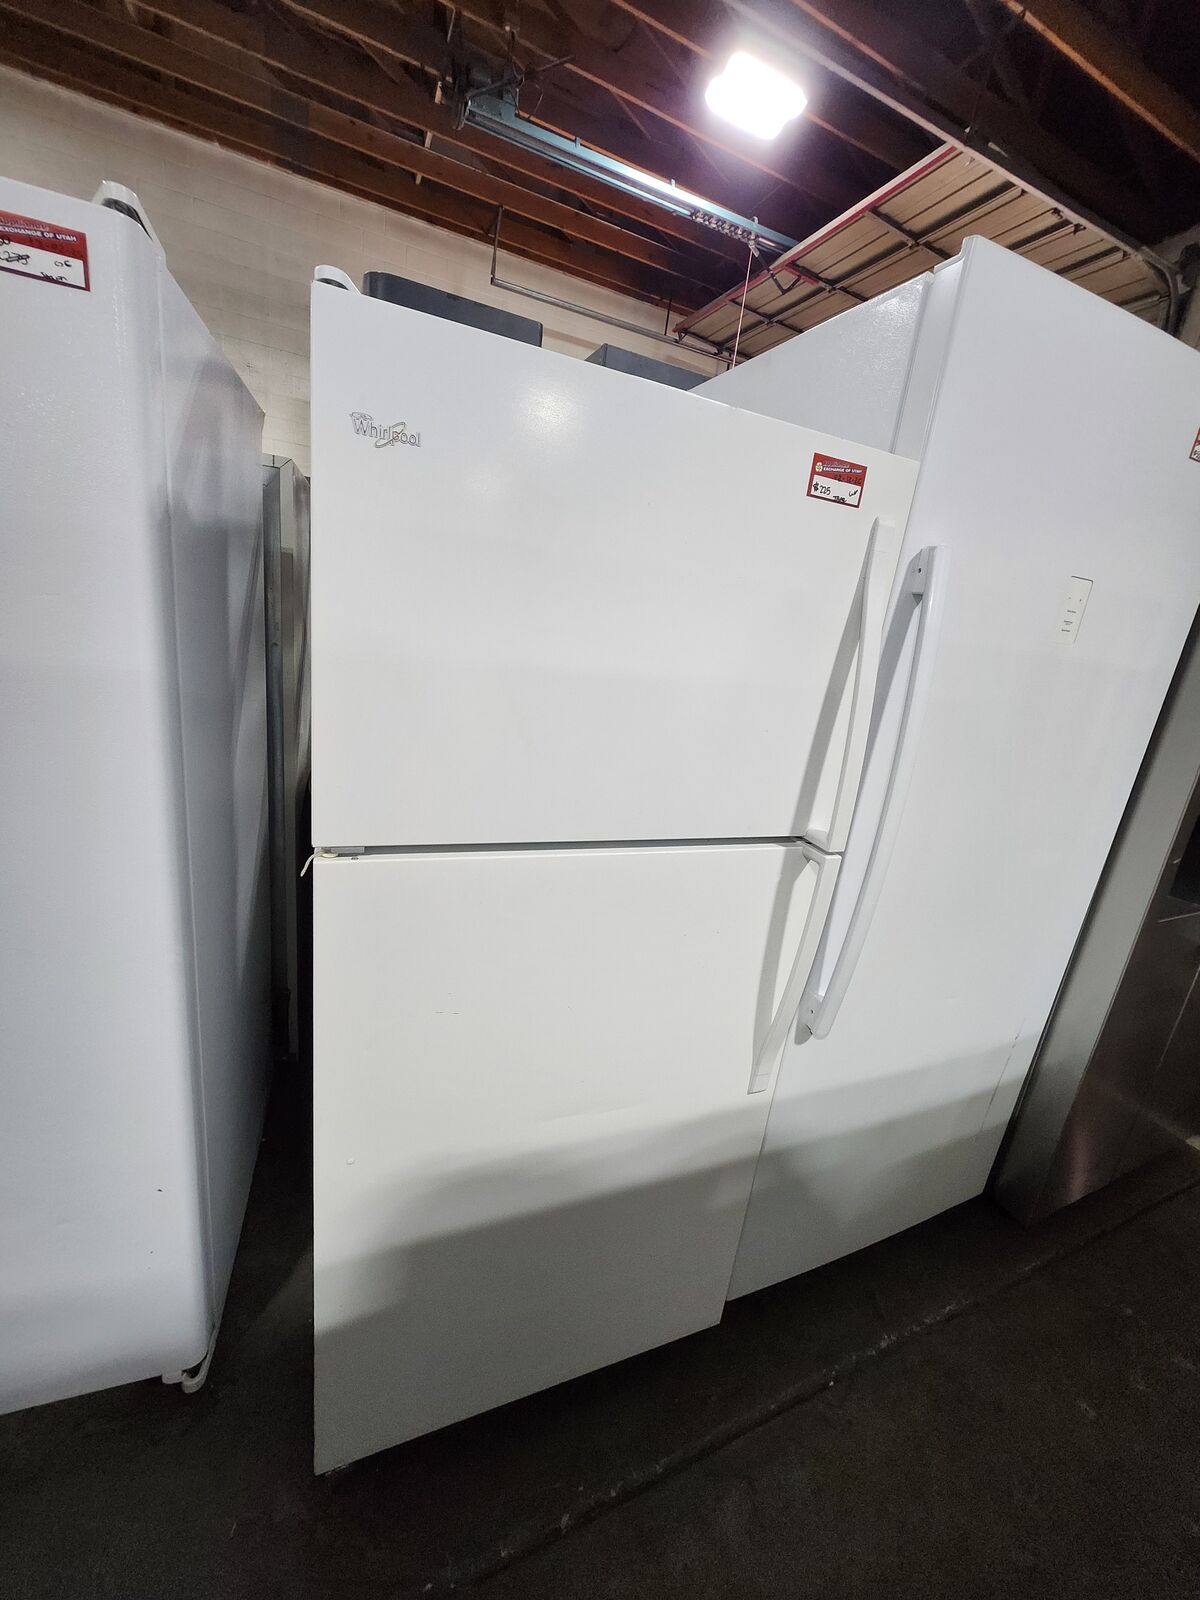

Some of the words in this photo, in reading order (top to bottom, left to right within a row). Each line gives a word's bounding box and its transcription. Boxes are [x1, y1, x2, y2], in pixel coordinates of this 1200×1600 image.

[0, 226, 43, 237] EXCHANGE
[43, 231, 55, 239] OF
[56, 233, 77, 241] UTAH
[349, 412, 421, 448] Whirlpool
